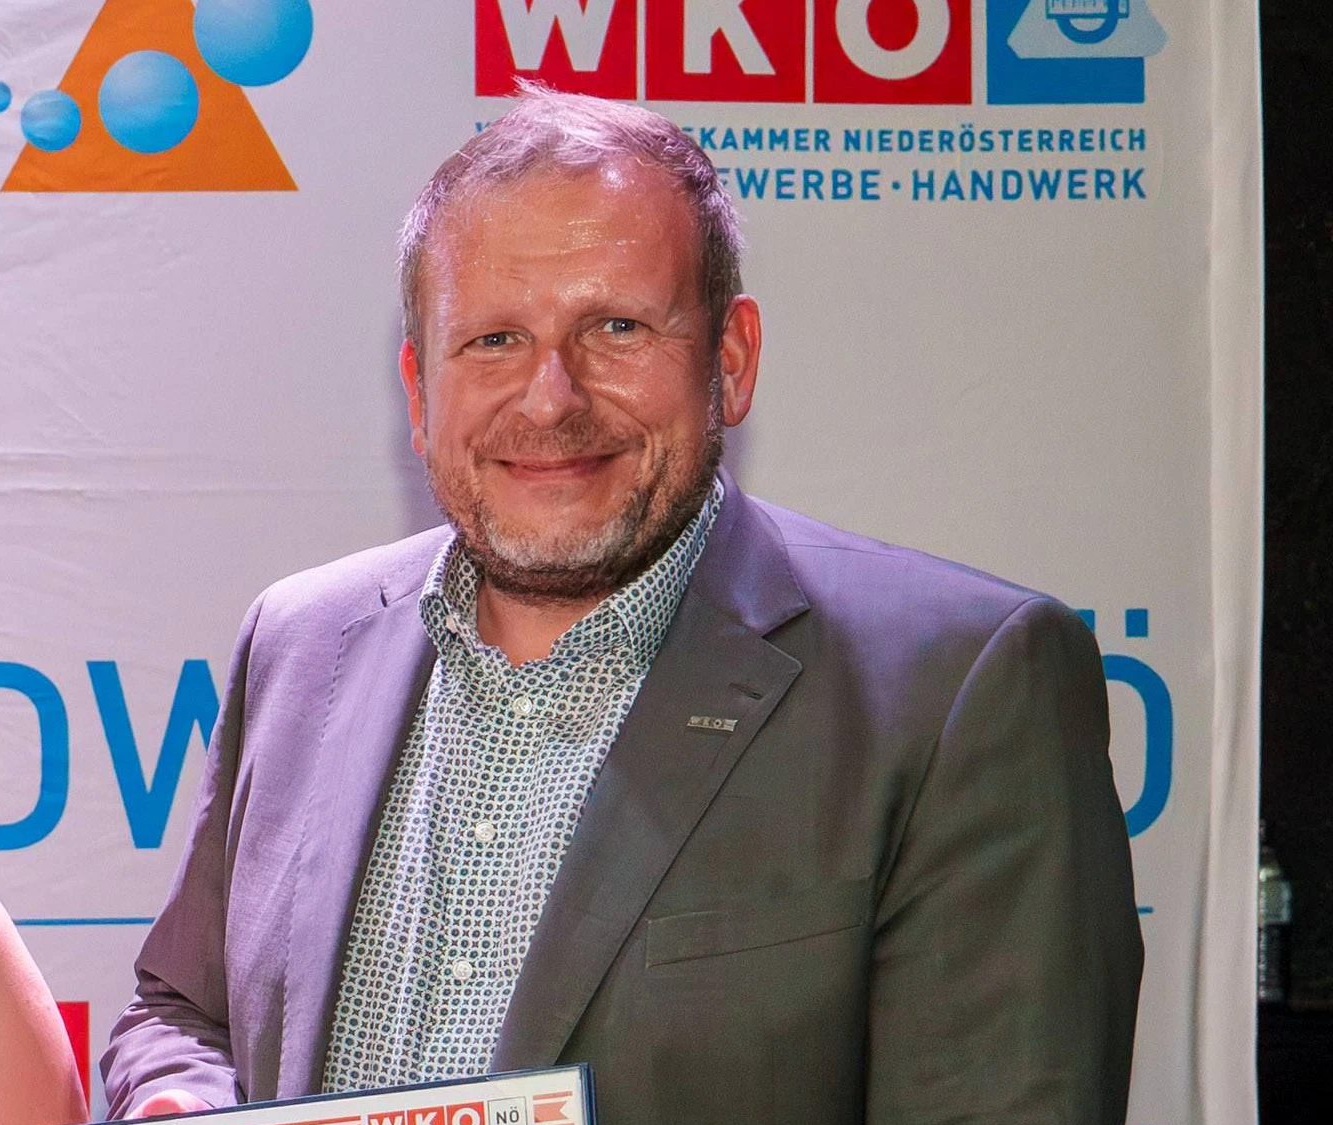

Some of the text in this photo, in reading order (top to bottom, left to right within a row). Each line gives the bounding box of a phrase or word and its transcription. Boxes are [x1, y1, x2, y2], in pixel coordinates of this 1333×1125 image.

[493, 0, 951, 80] WKO
[843, 125, 1146, 153] NIEDERÖSTERREICH
[911, 167, 1147, 202] HANDWERK
[496, 1106, 520, 1125] NÖ
